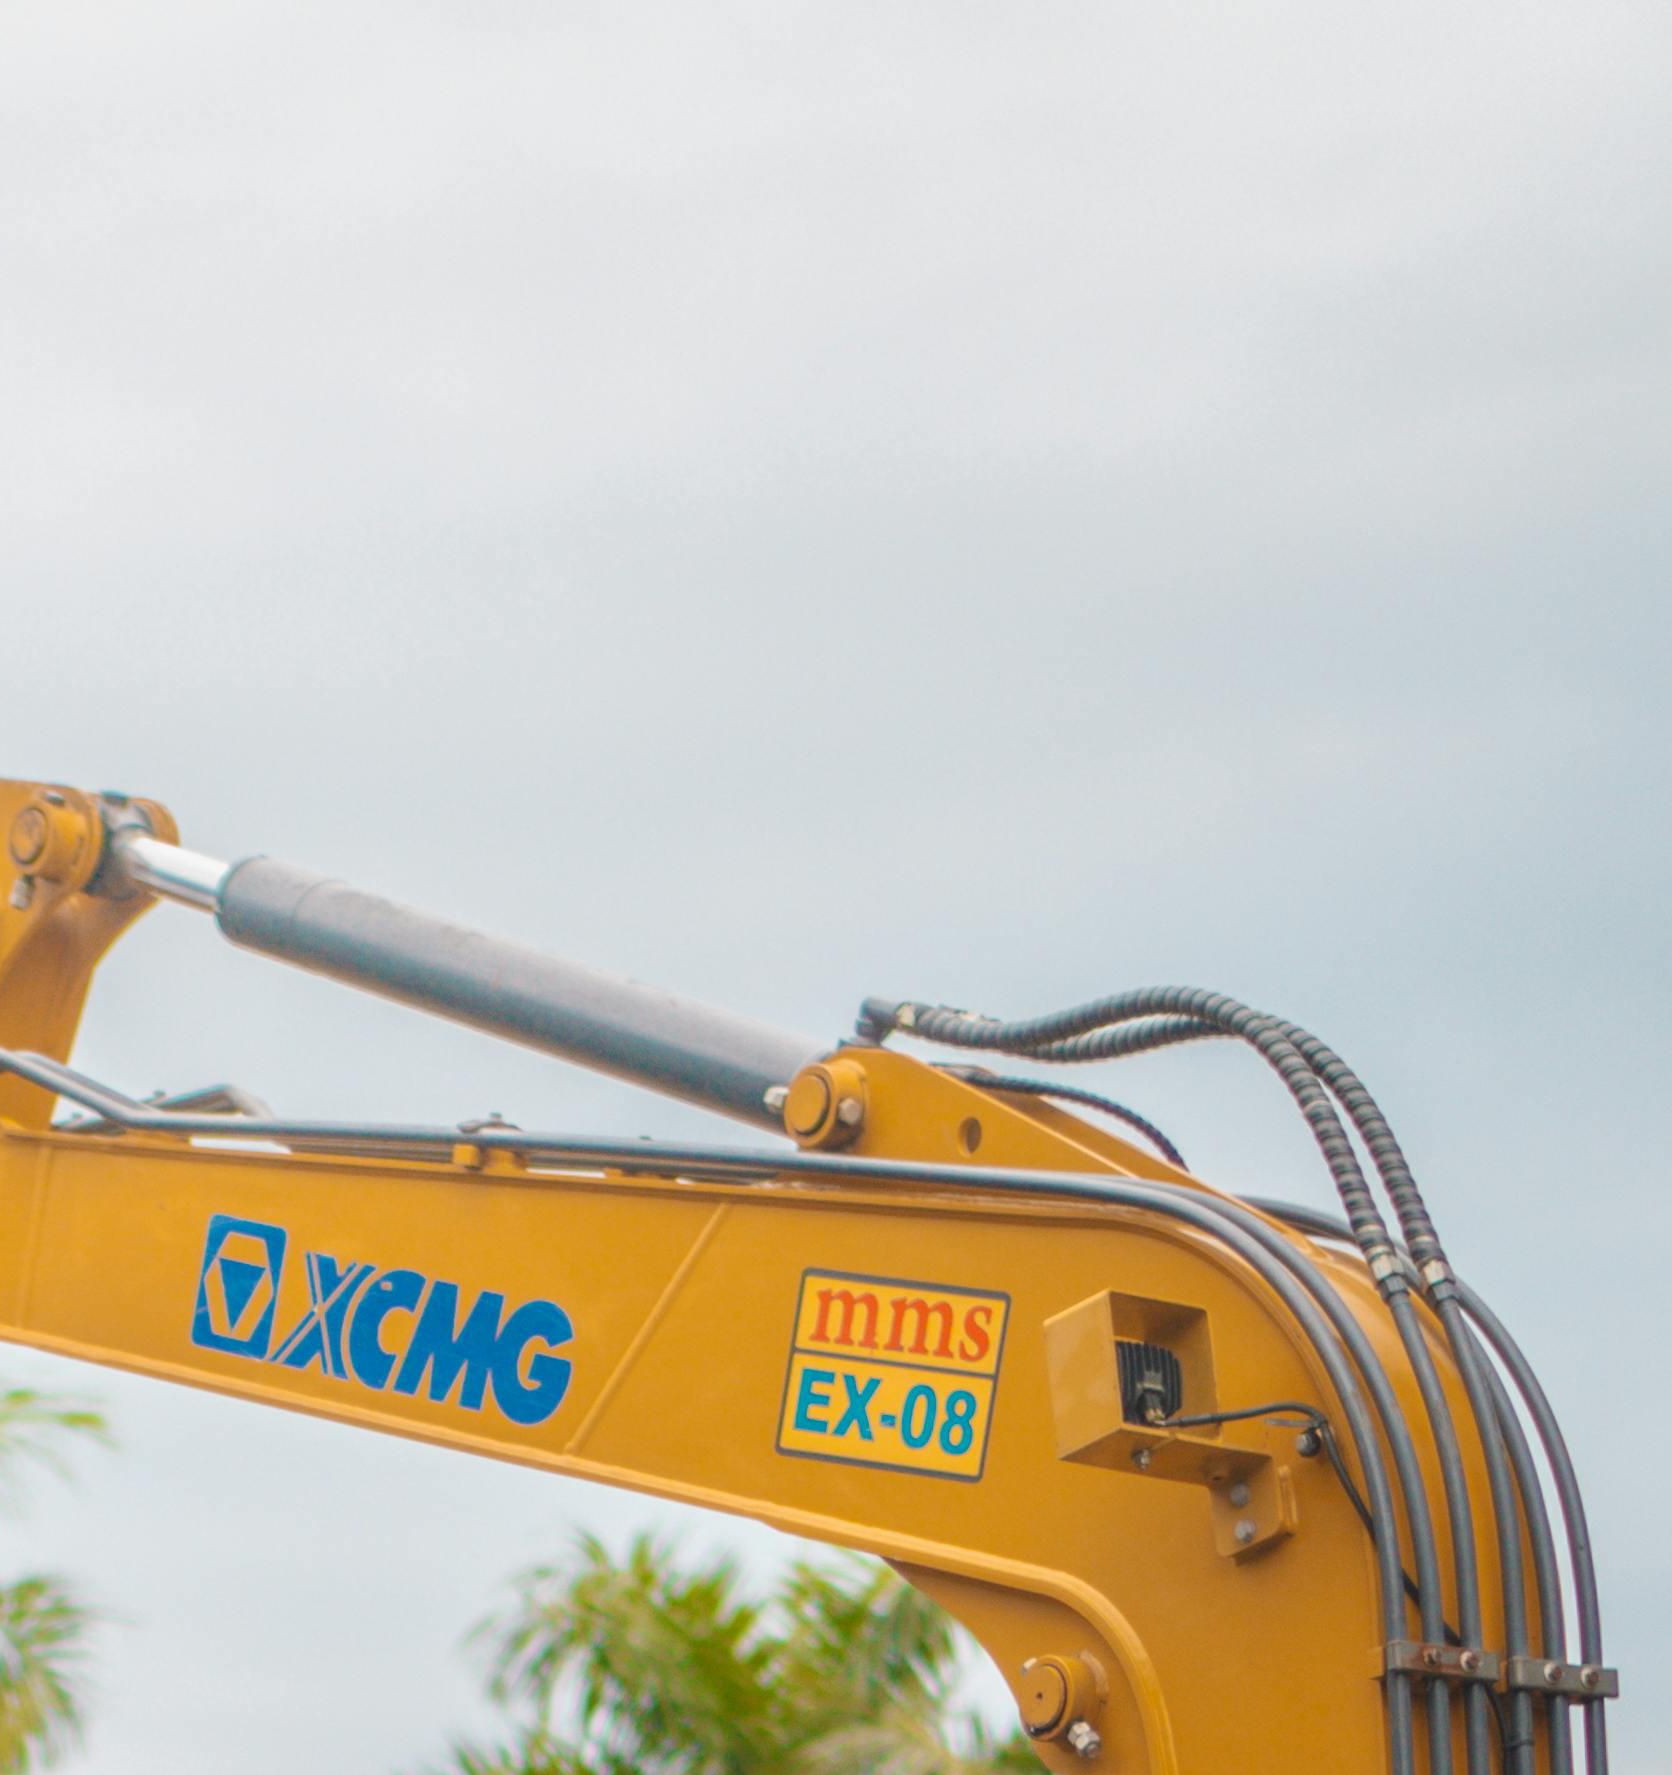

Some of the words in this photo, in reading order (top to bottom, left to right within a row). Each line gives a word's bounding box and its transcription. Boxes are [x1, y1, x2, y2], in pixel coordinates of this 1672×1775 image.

[274, 1250, 575, 1426] XCMG
[810, 1286, 993, 1363] mms
[792, 1367, 978, 1457] EX-08
